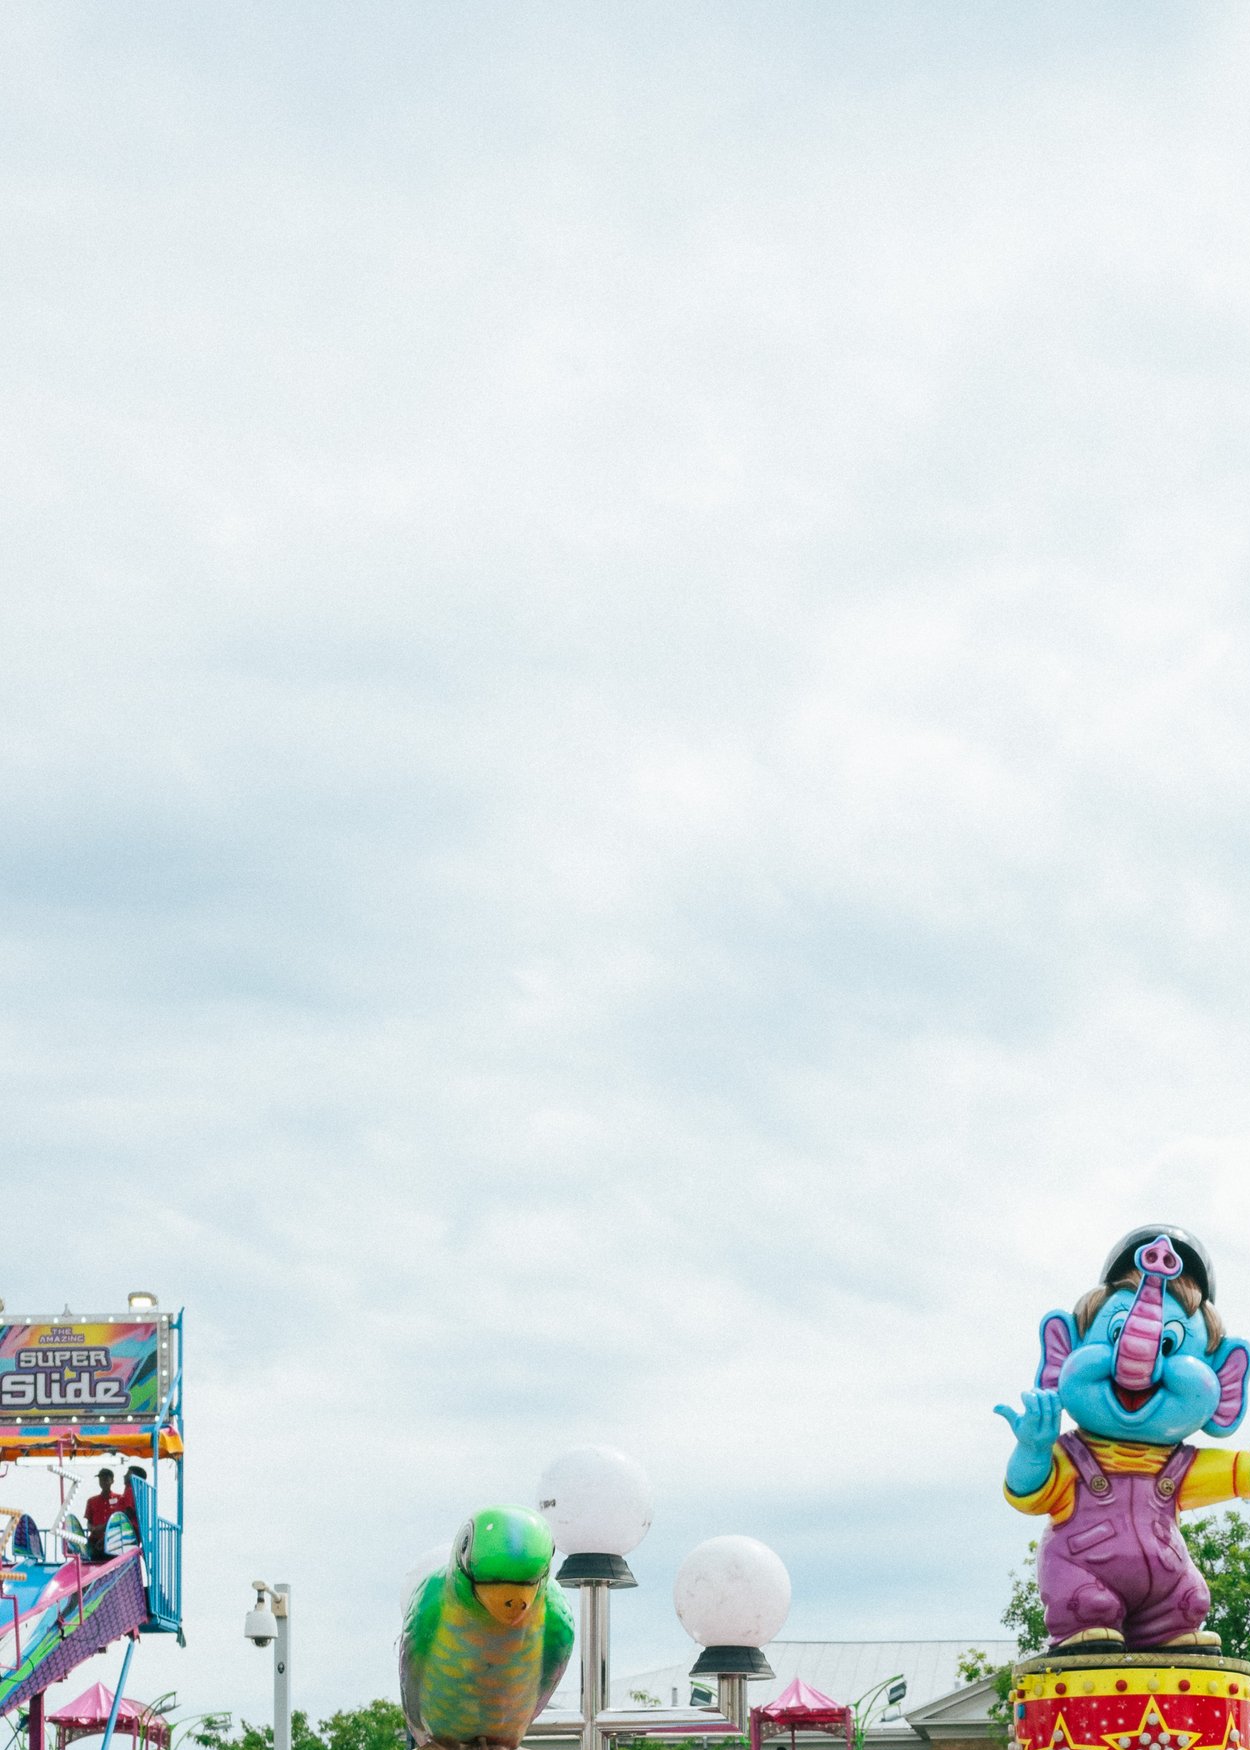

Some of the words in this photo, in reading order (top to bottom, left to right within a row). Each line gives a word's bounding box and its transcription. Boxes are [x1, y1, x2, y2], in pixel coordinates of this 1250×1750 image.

[40, 1335, 84, 1344] AMAZING
[20, 1351, 108, 1367] SUPER
[2, 1372, 126, 1405] Slide
